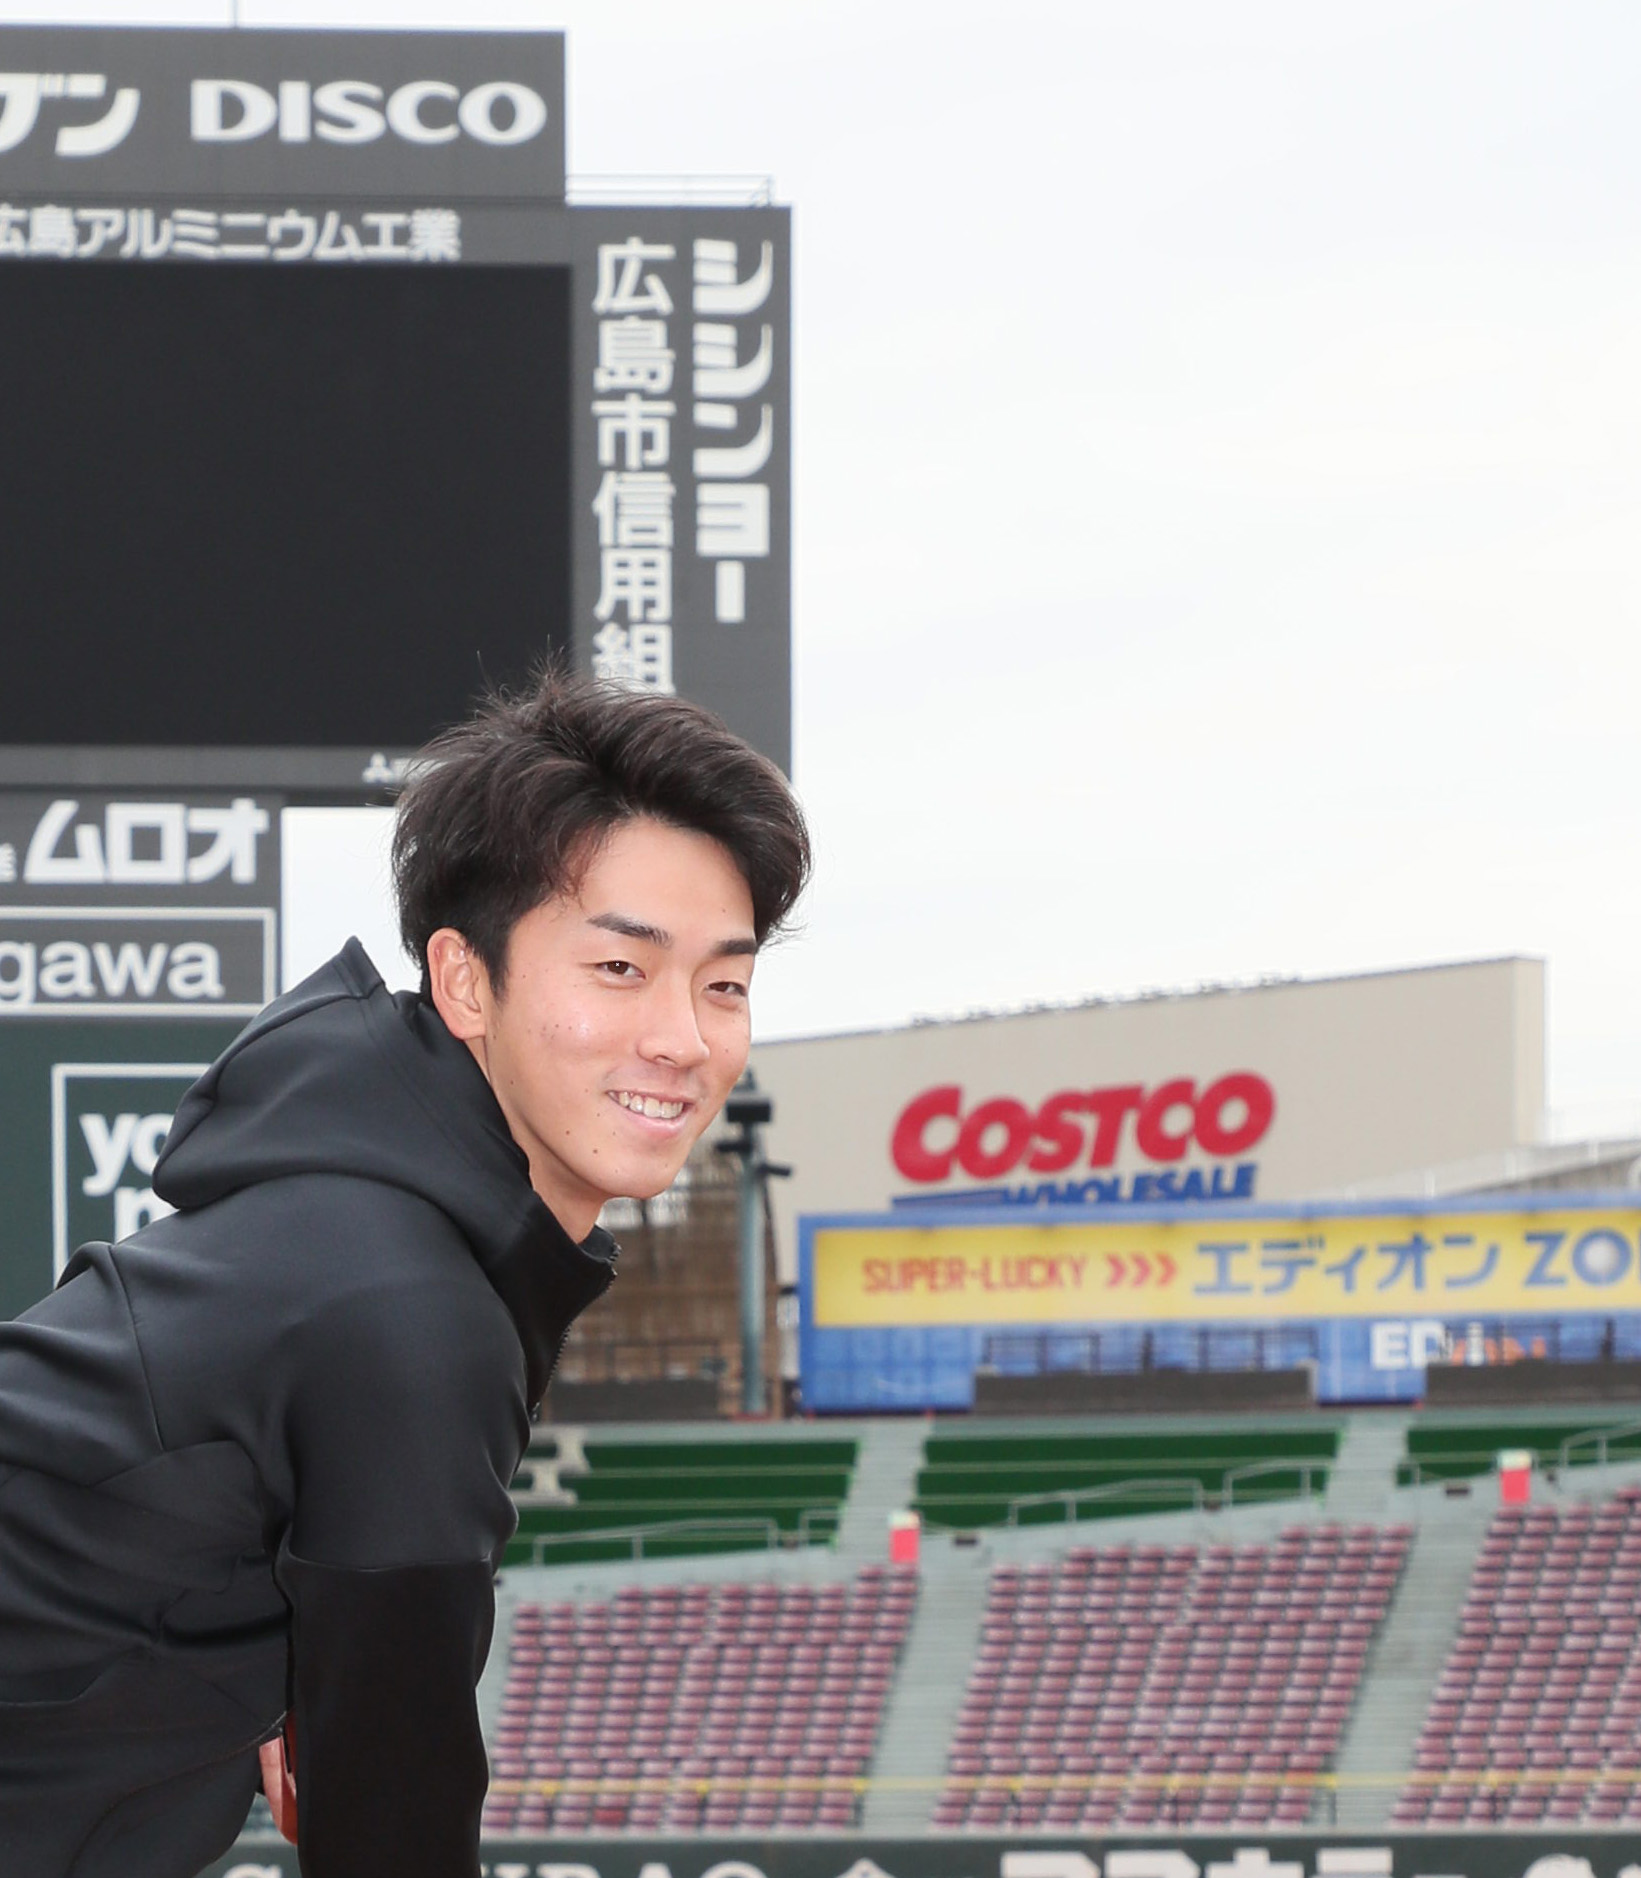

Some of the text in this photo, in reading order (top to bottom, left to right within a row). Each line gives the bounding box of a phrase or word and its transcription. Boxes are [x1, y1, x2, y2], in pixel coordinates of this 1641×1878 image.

[191, 80, 547, 144] DISCO
[693, 239, 772, 622] シシンヨー
[24, 799, 269, 884] ムロオ
[891, 1070, 1276, 1185] COSTCO
[1194, 1226, 1641, 1295] エディオン ZO
